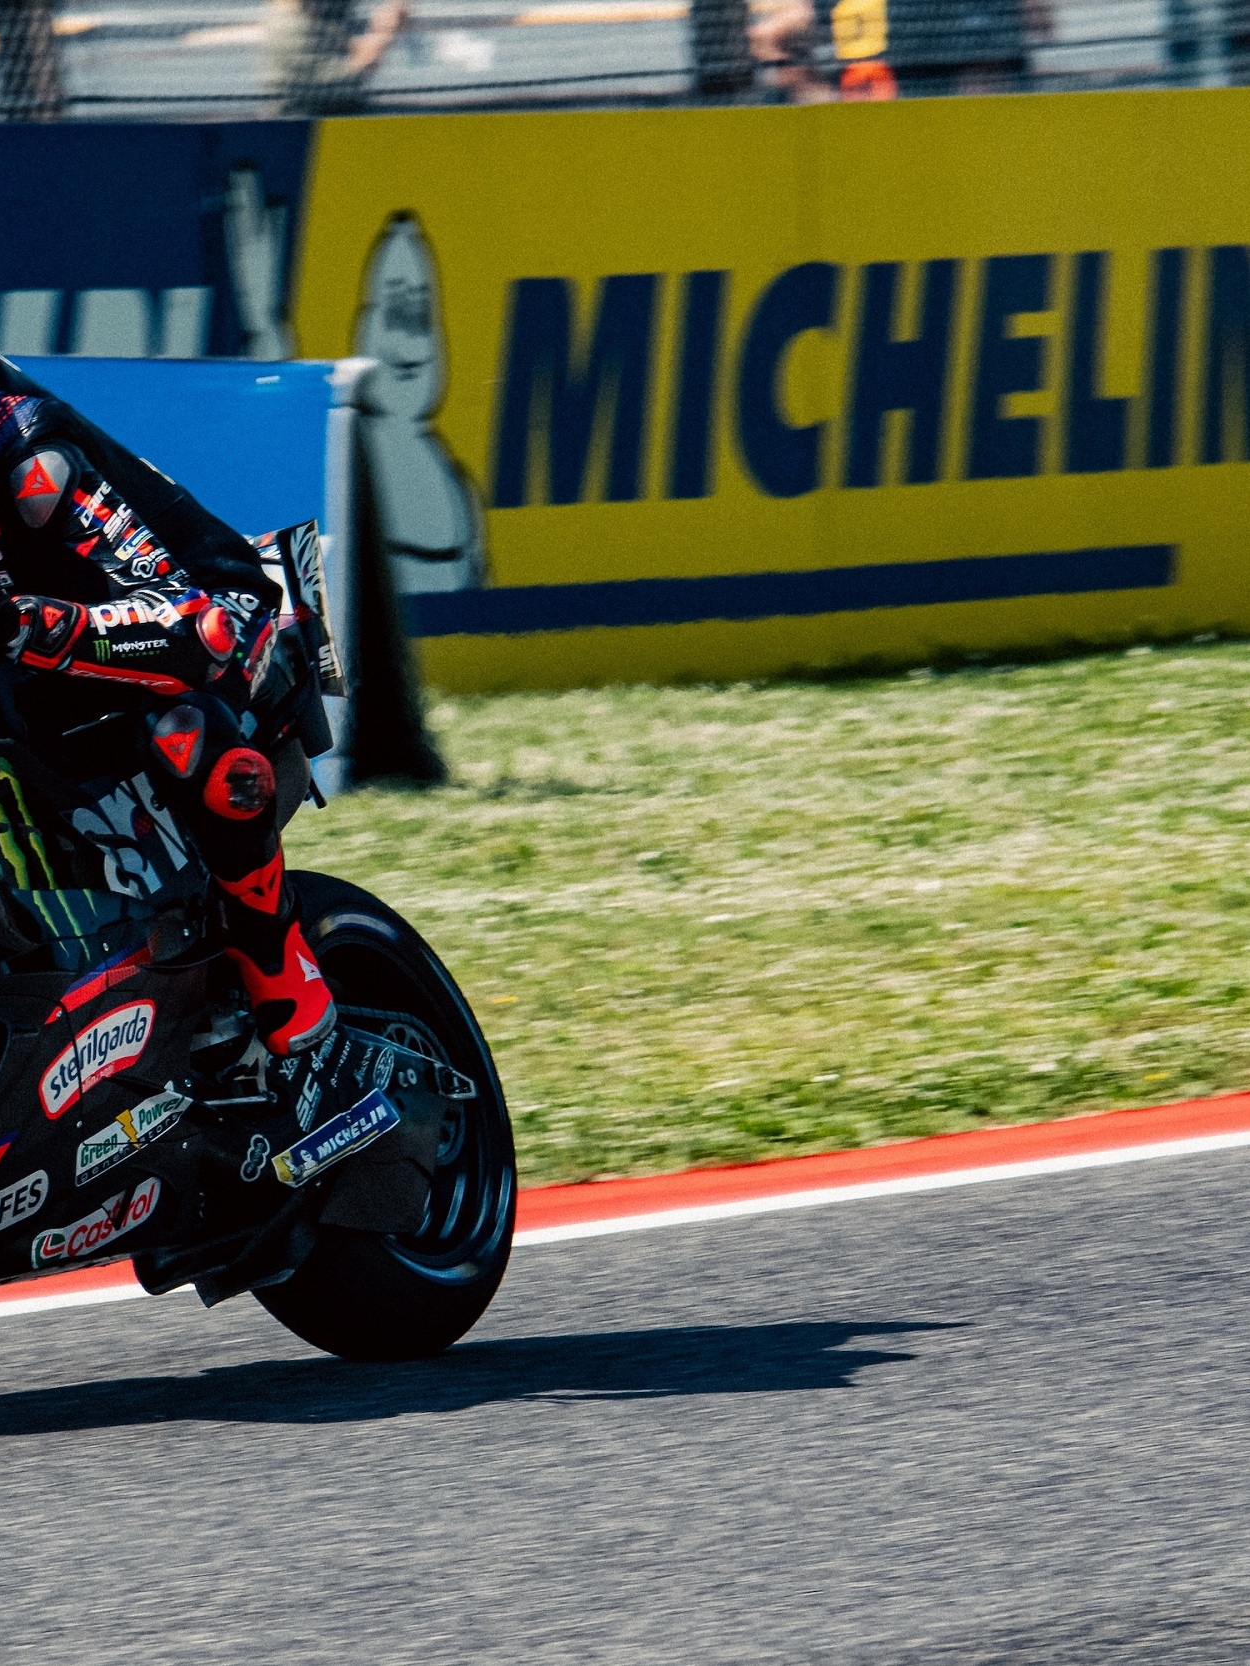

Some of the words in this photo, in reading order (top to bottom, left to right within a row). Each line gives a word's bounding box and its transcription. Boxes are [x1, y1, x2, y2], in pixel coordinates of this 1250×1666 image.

[112, 638, 169, 652] MONSTER
[50, 1007, 148, 1100] sterilgarda
[80, 1133, 118, 1168] Green
[316, 1104, 388, 1160] MICHELIN
